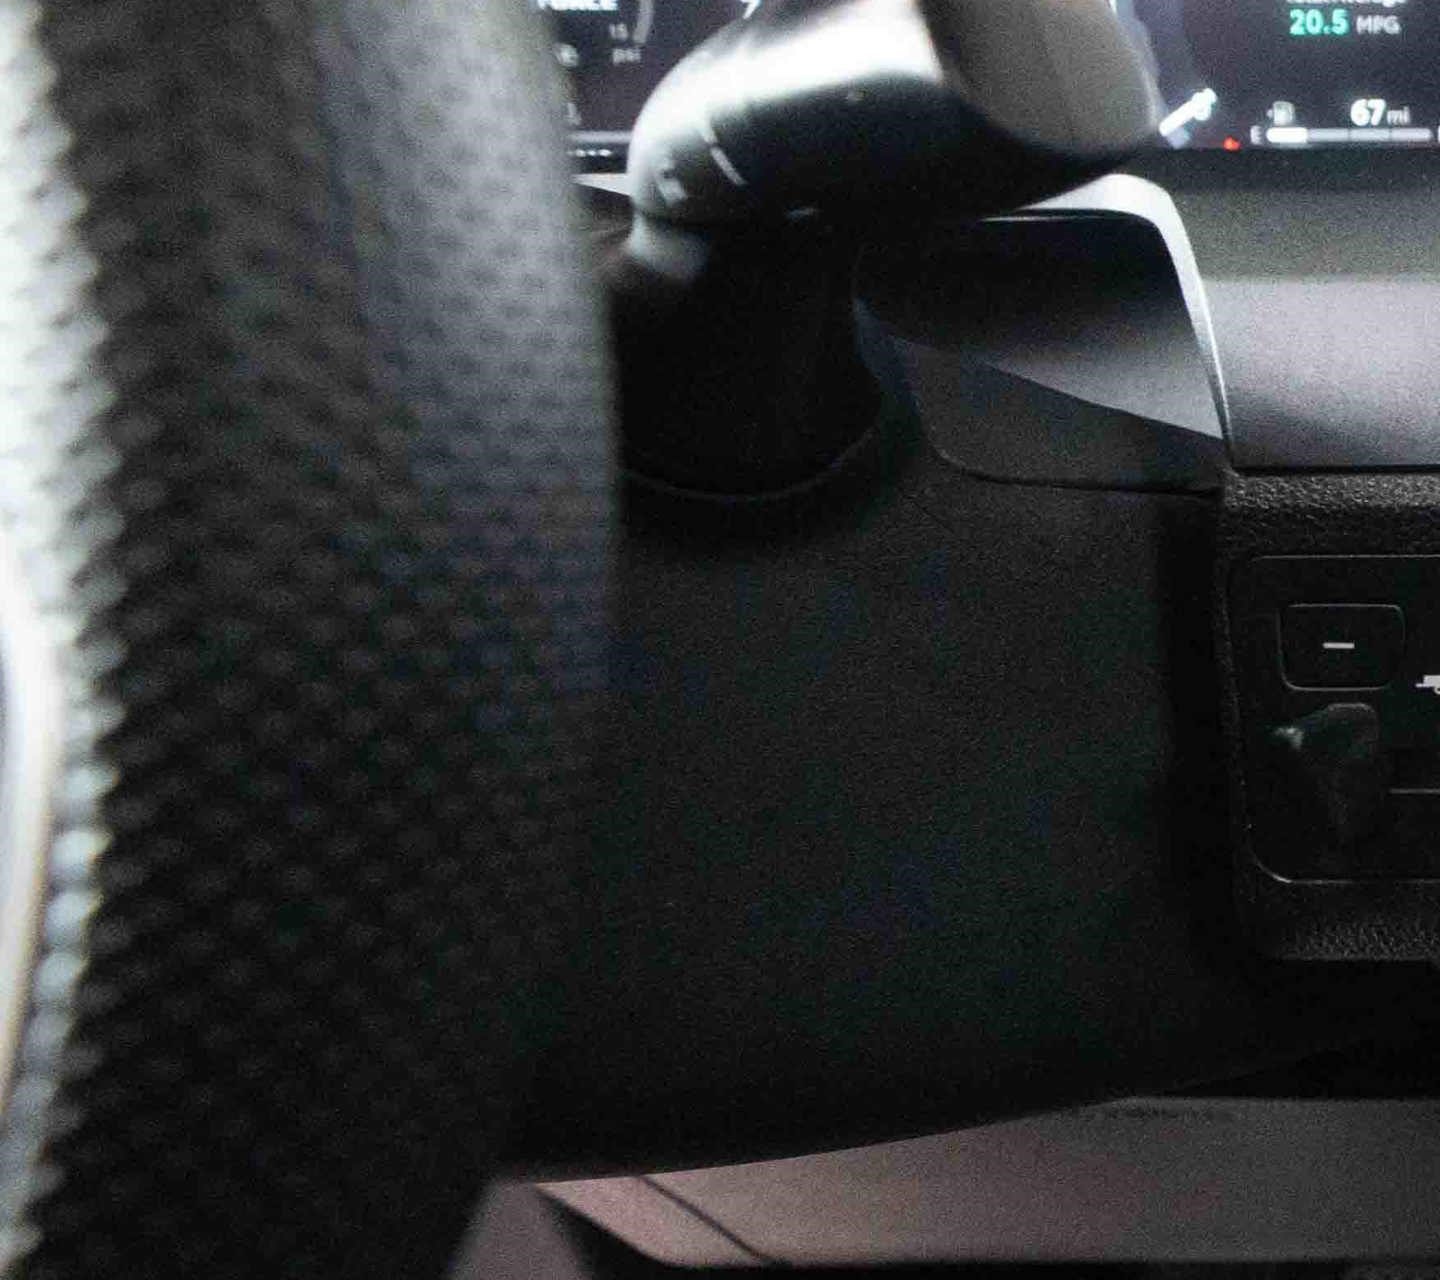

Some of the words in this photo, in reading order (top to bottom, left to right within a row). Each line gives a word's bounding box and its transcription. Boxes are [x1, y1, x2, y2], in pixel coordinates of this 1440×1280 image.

[1289, 8, 1349, 35] 20.5
[1356, 15, 1402, 35] MPG
[1350, 98, 1387, 126] 67
[1387, 106, 1411, 123] mi
